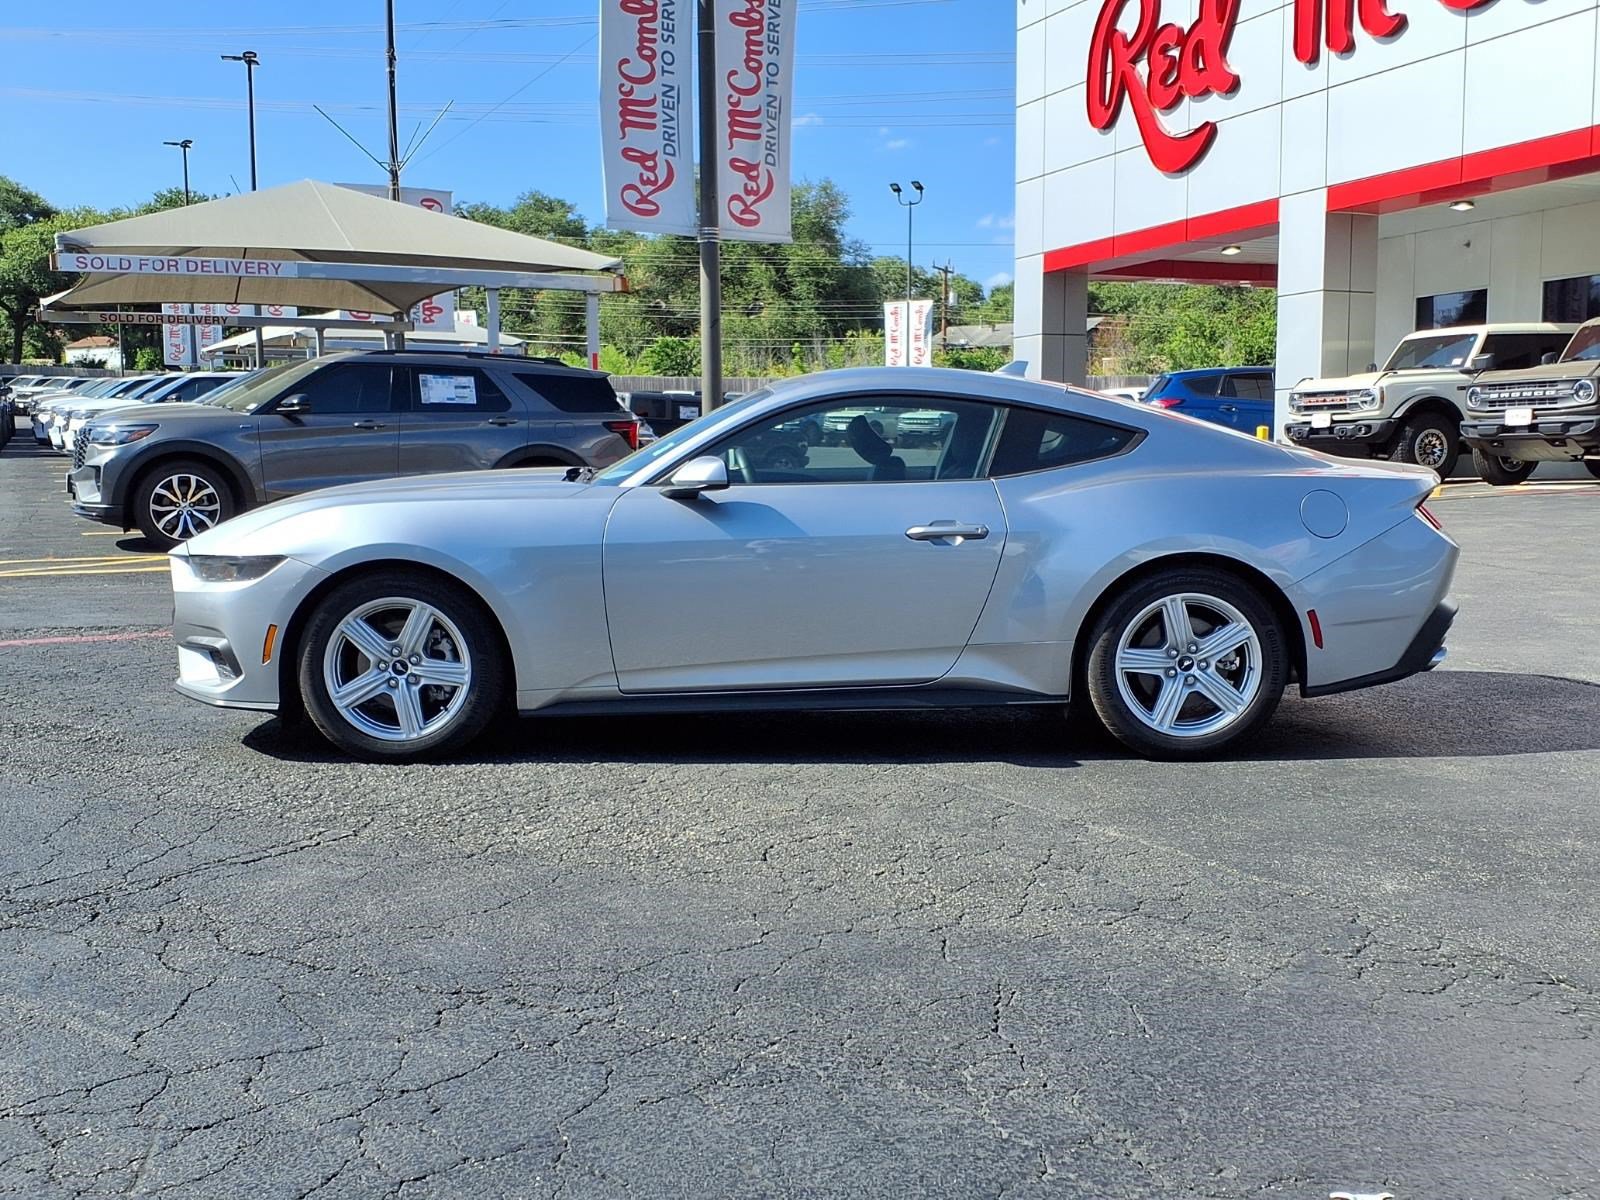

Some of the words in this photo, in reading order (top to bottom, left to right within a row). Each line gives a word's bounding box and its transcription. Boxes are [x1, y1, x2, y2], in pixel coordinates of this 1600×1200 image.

[661, 0, 675, 45] SERV
[767, 0, 781, 57] SERVE
[617, 0, 659, 140] McComb
[661, 50, 675, 77] TO
[766, 62, 780, 88] TO
[1086, 0, 1241, 174] Red
[663, 84, 677, 157] DRIVEN
[764, 95, 777, 167] DRIVEN
[620, 147, 675, 217] Red
[727, 157, 774, 227] Red
[75, 256, 132, 271] SOLD
[139, 258, 179, 272] FOR
[186, 259, 282, 275] DELIVERY
[100, 313, 135, 323] SOLD
[138, 314, 164, 324] FOR
[168, 315, 228, 325] DELIVERY
[1489, 390, 1557, 399] BRONCO
